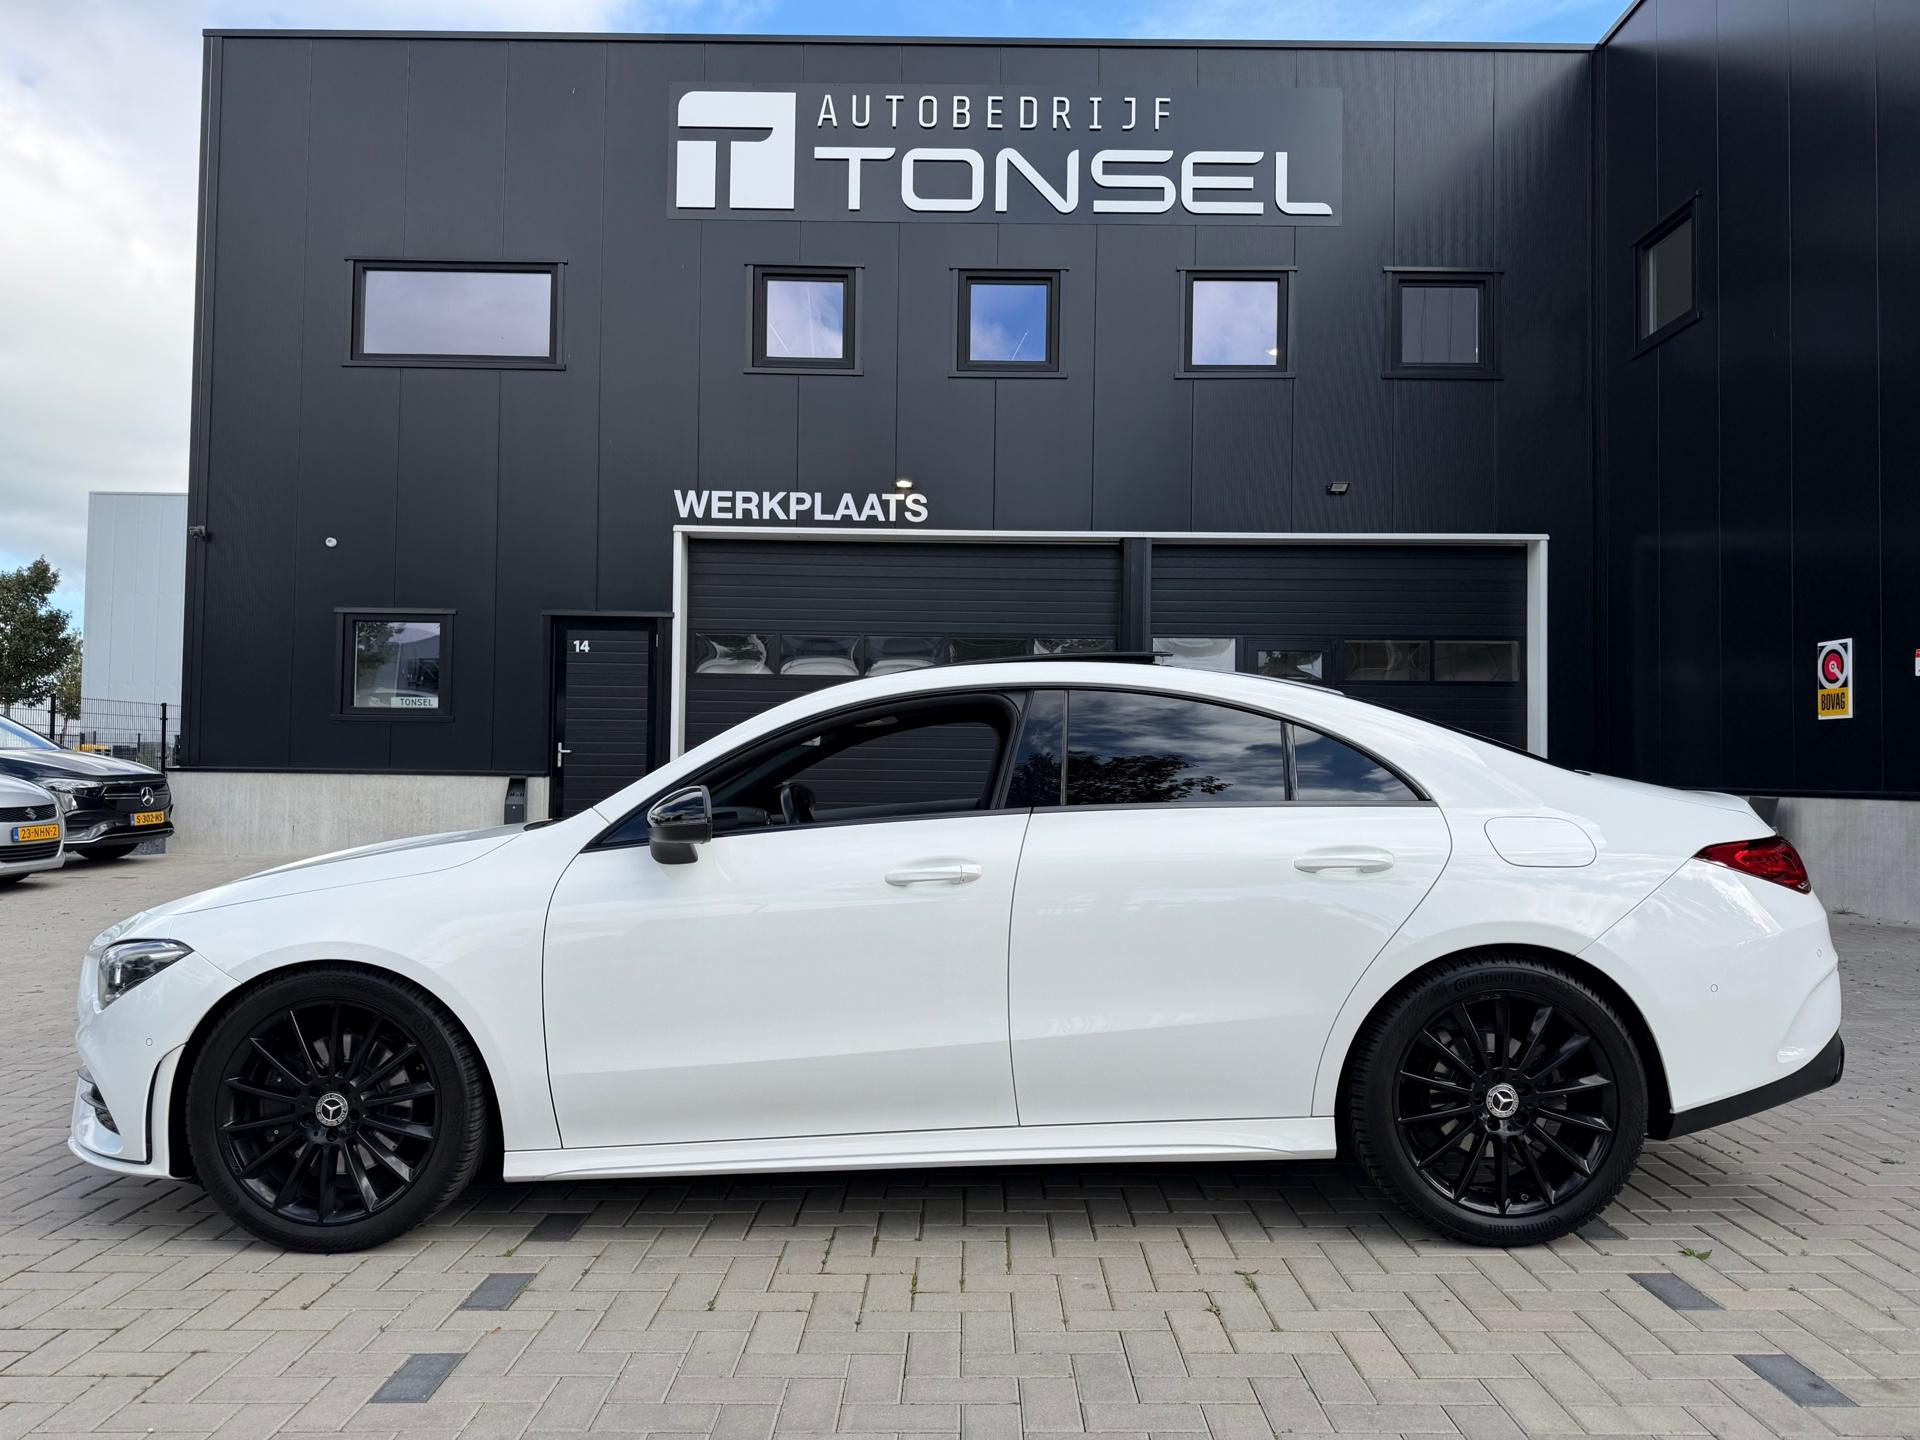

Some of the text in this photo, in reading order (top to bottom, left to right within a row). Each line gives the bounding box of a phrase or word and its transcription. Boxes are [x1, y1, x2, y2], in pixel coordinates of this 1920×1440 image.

[816, 93, 1172, 131] AUTOBEDRIJF
[814, 146, 1333, 215] TONSEL
[673, 489, 929, 523] WERKPLAATS
[573, 640, 590, 653] 14
[400, 698, 433, 707] TONSEL
[1821, 692, 1846, 711] BOVAG
[21, 826, 57, 840] 23-NHN-2
